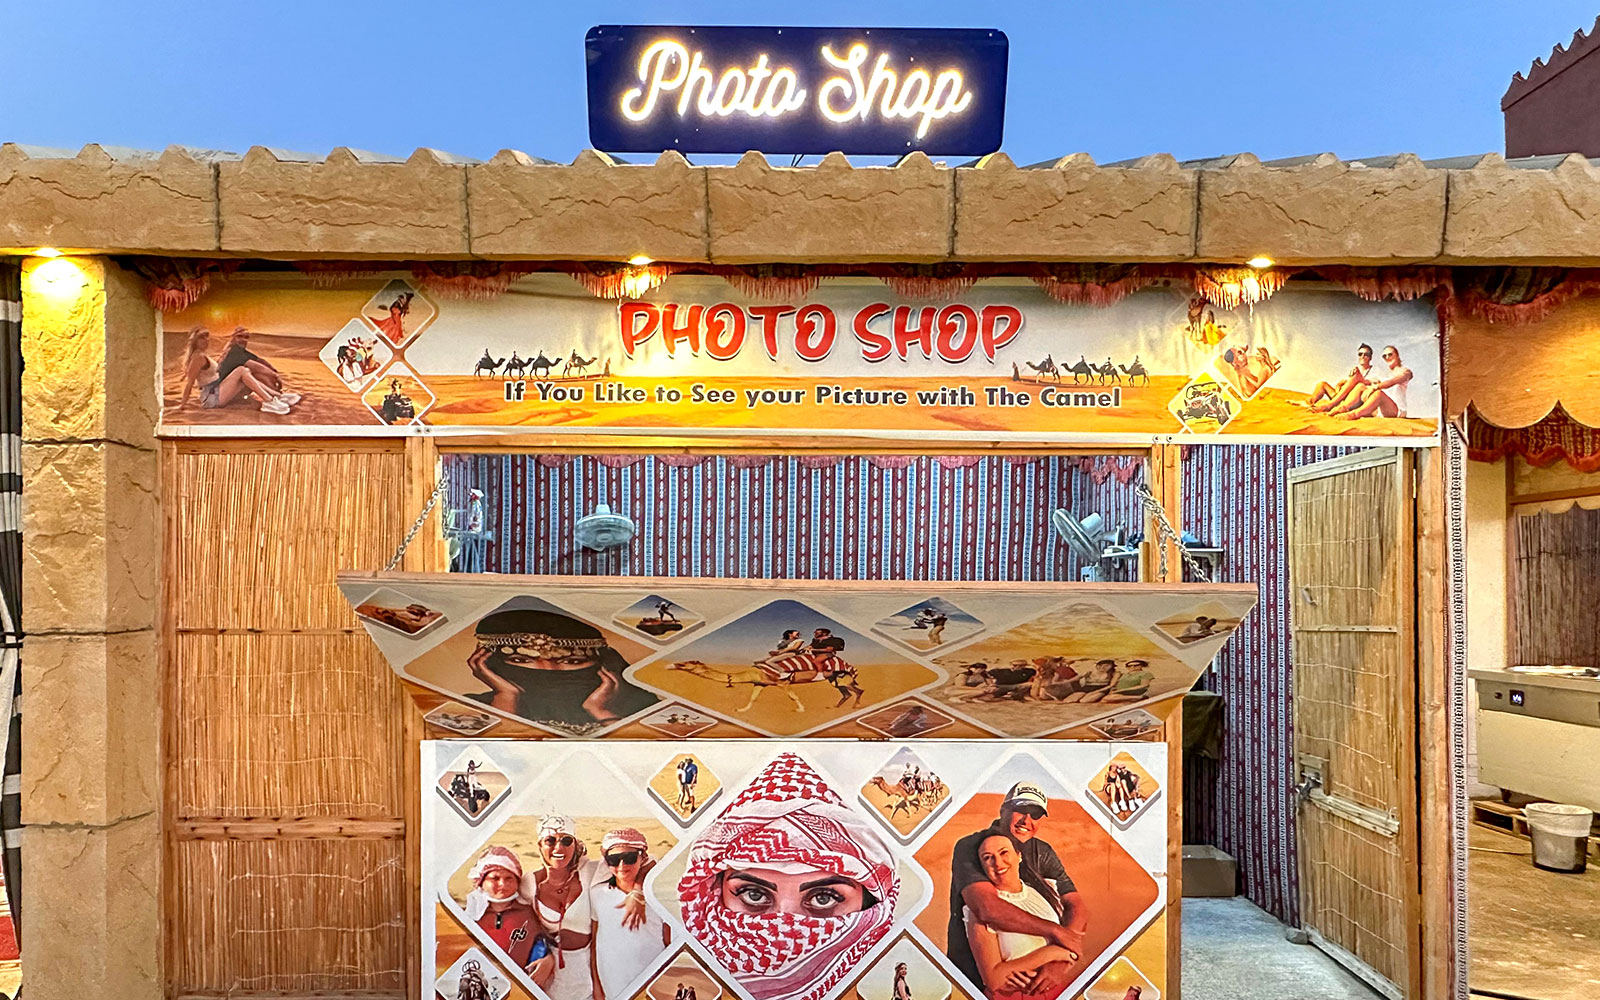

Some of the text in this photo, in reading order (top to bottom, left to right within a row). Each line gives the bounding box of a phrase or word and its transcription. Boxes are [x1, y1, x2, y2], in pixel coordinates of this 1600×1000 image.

[620, 39, 973, 139] Photo Shop
[618, 302, 1025, 364] PHOTO SHOP
[505, 382, 1121, 408] If You Like to See your Picture with The Camel
